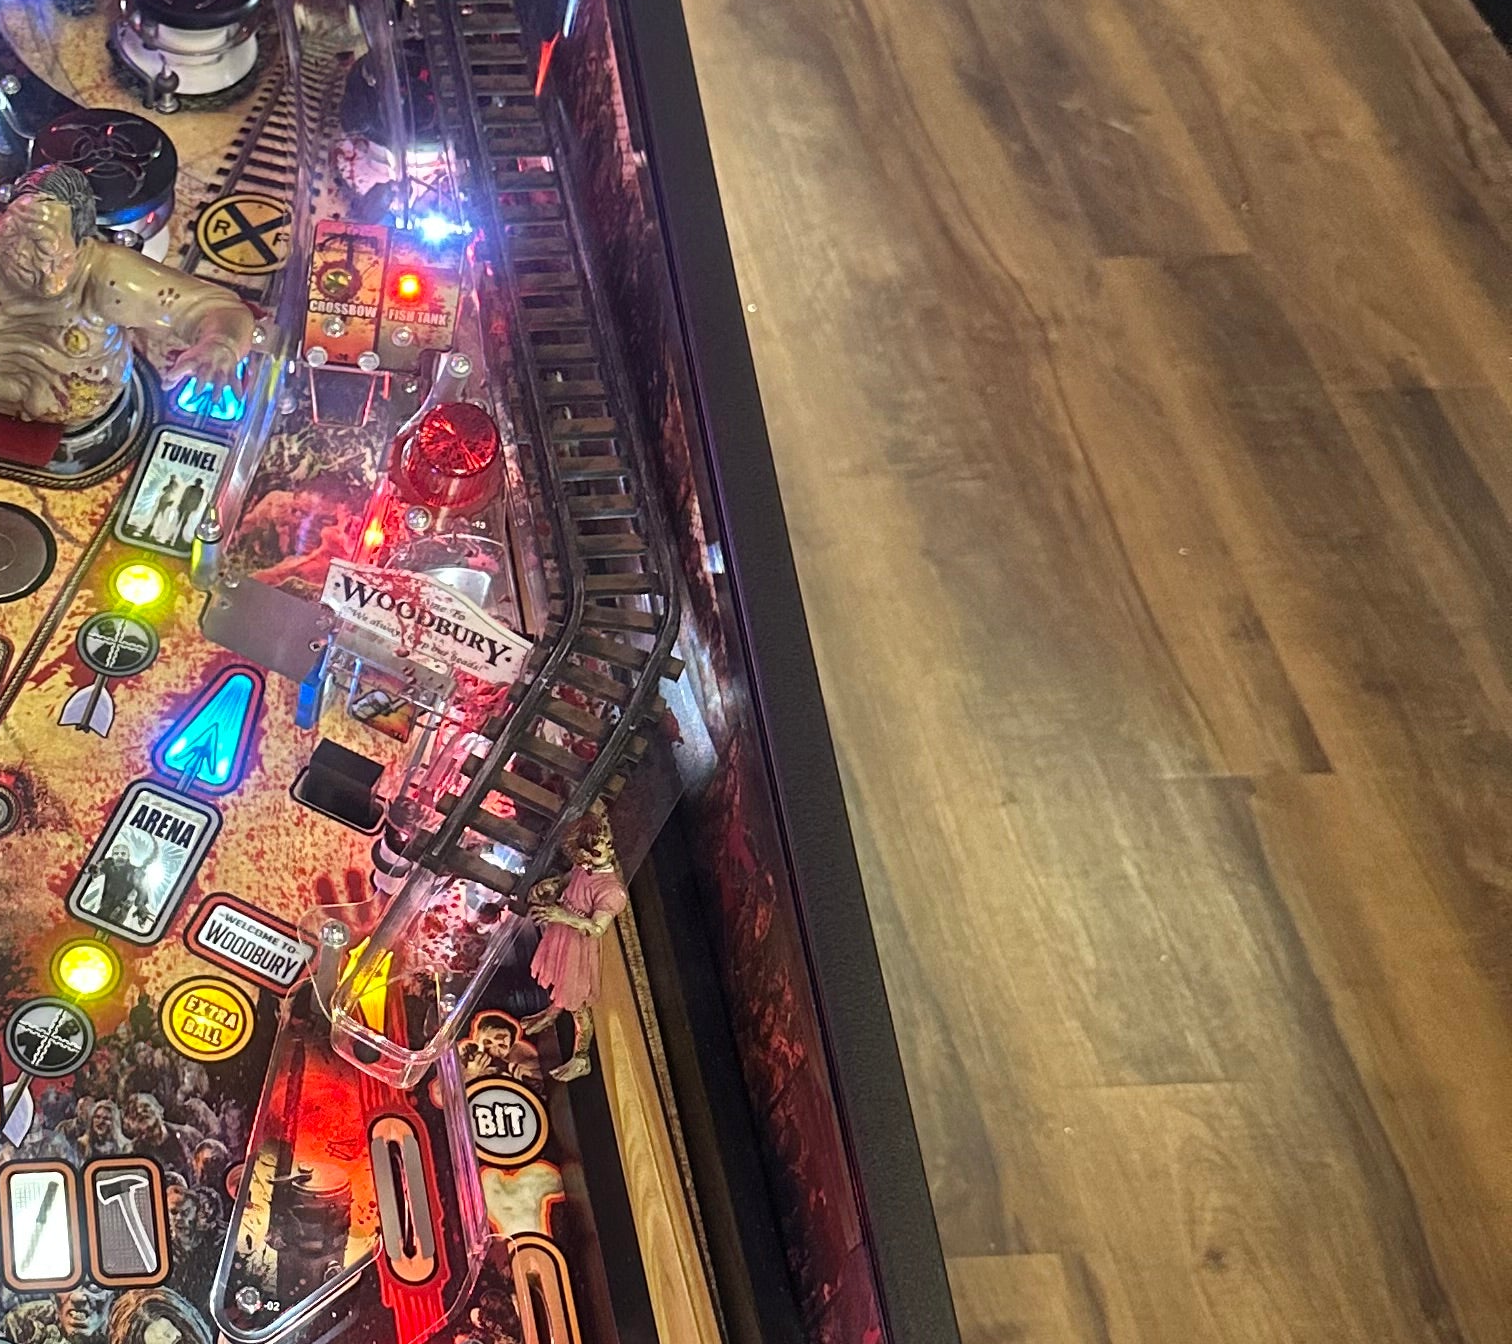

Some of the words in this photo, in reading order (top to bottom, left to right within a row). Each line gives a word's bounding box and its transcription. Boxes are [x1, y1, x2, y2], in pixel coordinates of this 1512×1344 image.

[212, 219, 231, 235] R
[309, 299, 379, 318] CROSSBOW
[387, 308, 416, 323] FISH
[417, 311, 448, 326] TANK
[160, 441, 217, 472] TUNNEL
[341, 574, 512, 667] WOODBURY
[129, 804, 197, 850] ARENA
[205, 919, 299, 980] WOODBURY
[184, 994, 238, 1031] EXTRA
[181, 1016, 222, 1047] BALL
[472, 1102, 526, 1138] BIT
